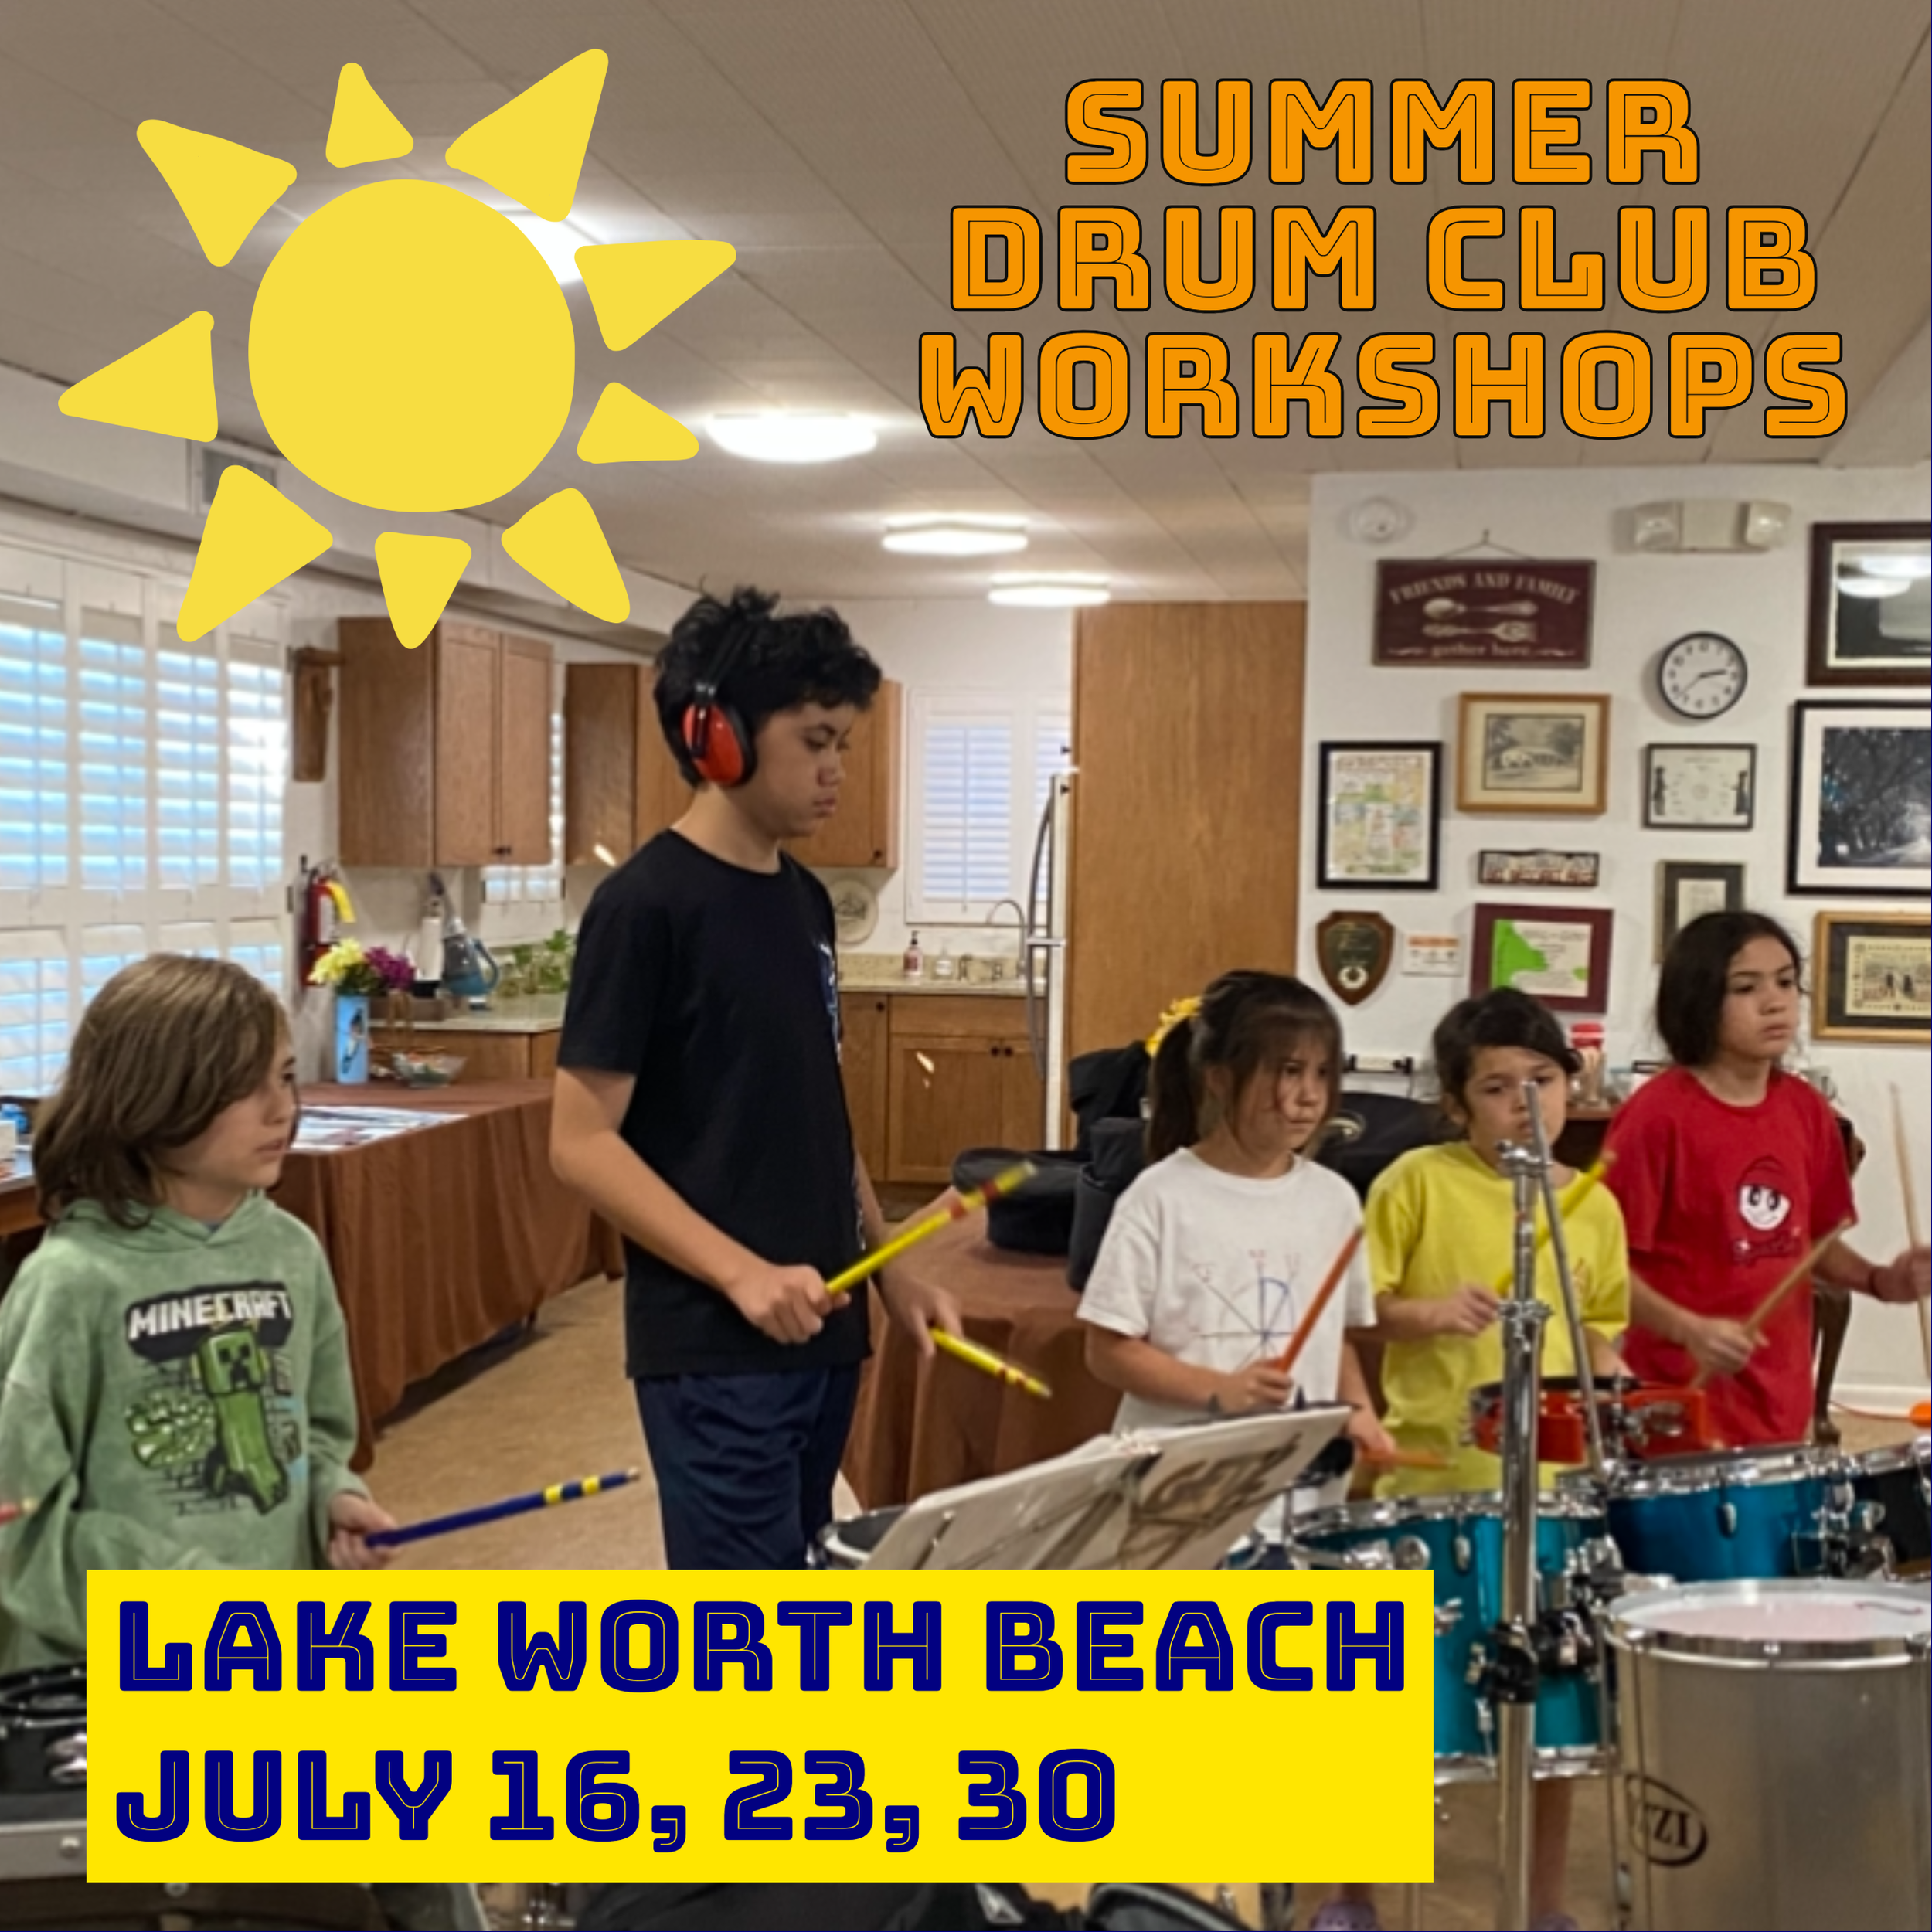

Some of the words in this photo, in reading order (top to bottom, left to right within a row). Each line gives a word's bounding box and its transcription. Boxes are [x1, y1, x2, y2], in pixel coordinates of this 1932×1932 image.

[1389, 573, 1466, 604] FRIENDS
[1474, 571, 1510, 589] AND
[1515, 574, 1580, 604] FAMILY
[128, 1288, 291, 1341] MINECRAFT
